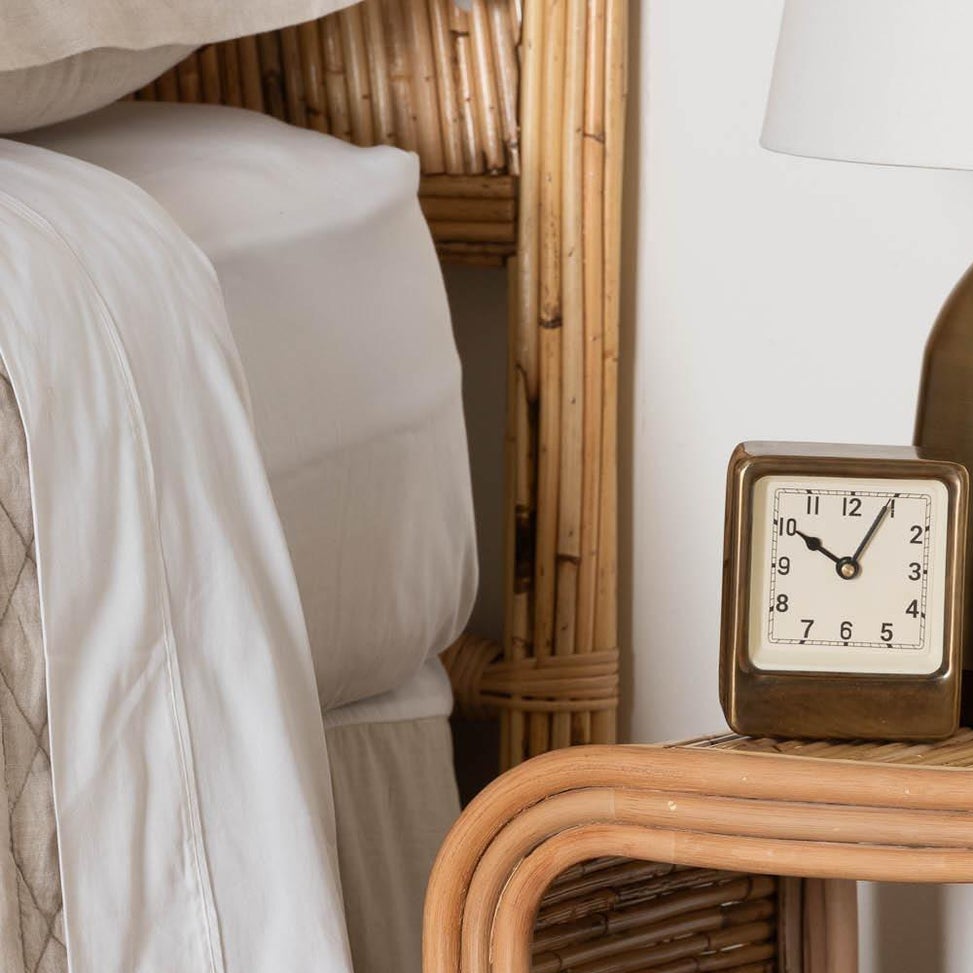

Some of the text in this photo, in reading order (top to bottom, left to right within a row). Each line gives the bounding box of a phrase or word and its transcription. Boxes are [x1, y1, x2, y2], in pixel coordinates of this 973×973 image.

[806, 496, 819, 515] 11
[842, 497, 862, 516] 12
[779, 517, 797, 536] 10
[909, 525, 923, 544] 2
[777, 556, 790, 575] 9
[908, 562, 922, 581] 3
[775, 594, 789, 612] 8
[905, 599, 920, 618] 4
[800, 619, 815, 638] 7
[840, 621, 853, 640] 6
[880, 622, 894, 641] 5
